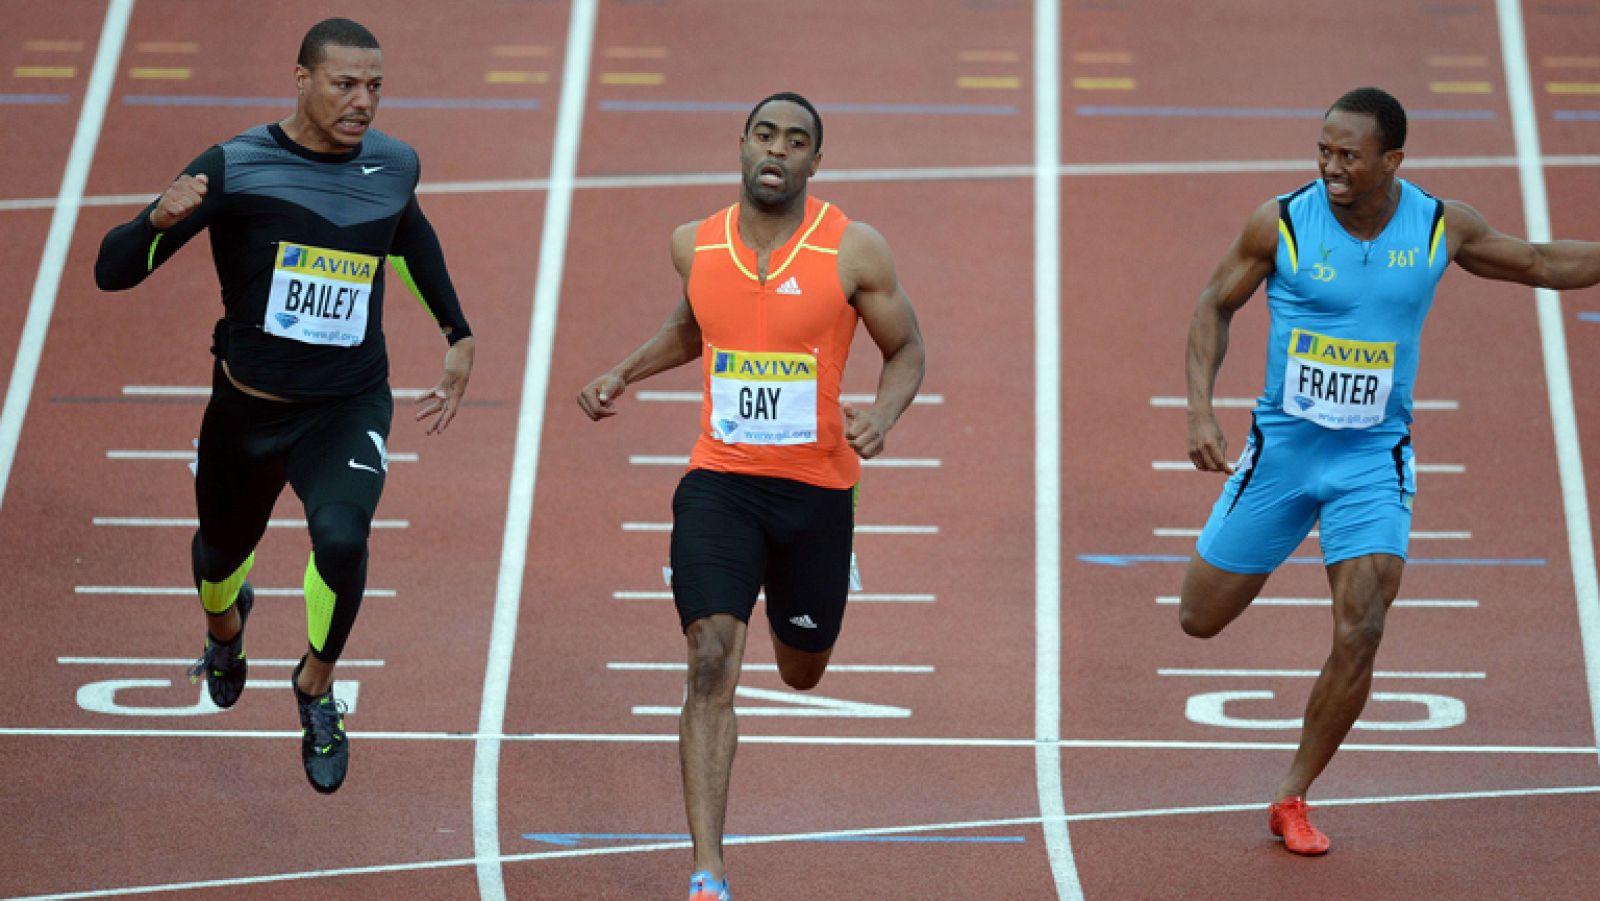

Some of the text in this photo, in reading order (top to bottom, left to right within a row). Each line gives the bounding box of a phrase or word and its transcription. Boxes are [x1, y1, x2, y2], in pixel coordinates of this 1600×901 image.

[311, 256, 371, 278] AVIVA
[285, 279, 360, 321] BAILEY
[740, 359, 810, 376] AVIVA
[1321, 344, 1389, 364] AVIVA
[1298, 364, 1380, 406] FRATER
[739, 386, 782, 420] GAY
